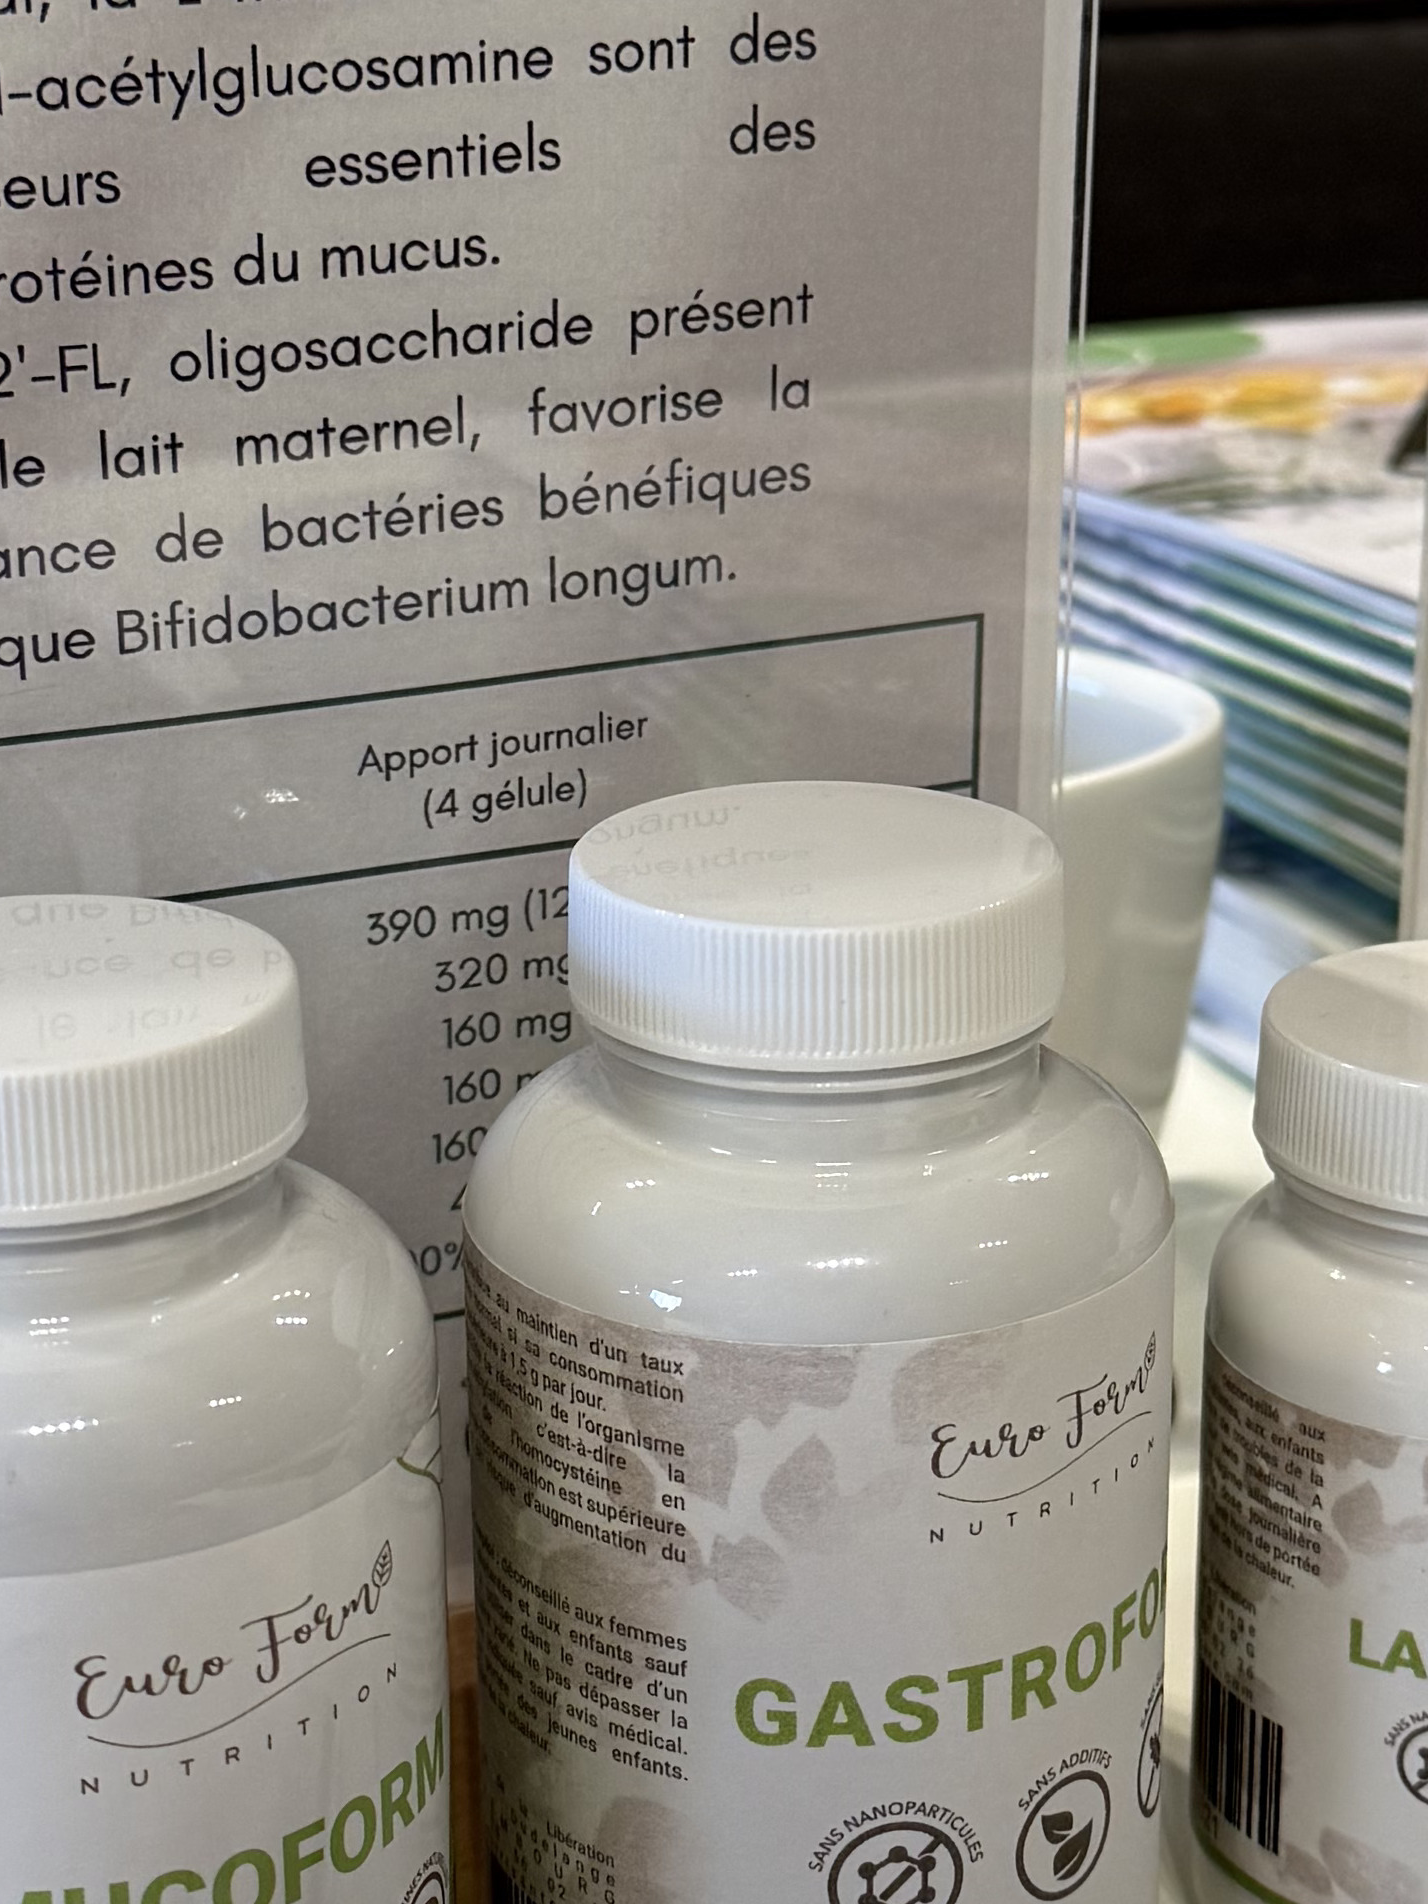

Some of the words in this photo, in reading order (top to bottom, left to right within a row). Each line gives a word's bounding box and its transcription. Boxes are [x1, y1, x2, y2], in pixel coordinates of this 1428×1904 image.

[117, 577, 528, 655] Bifidobacterium
[549, 554, 736, 607] longum.
[357, 734, 478, 782] Apport
[488, 711, 648, 768] journalier
[424, 788, 459, 829] (4
[472, 768, 586, 823] gélule)
[367, 905, 436, 945] 390
[452, 905, 509, 938] mg
[74, 1654, 235, 1723] Euro
[240, 1584, 384, 1686] Form
[608, 1617, 688, 1652] femmes
[734, 1547, 1167, 1749] GASTROFO
[79, 1664, 400, 1796] NUTRITION
[611, 1743, 689, 1782] enfants.
